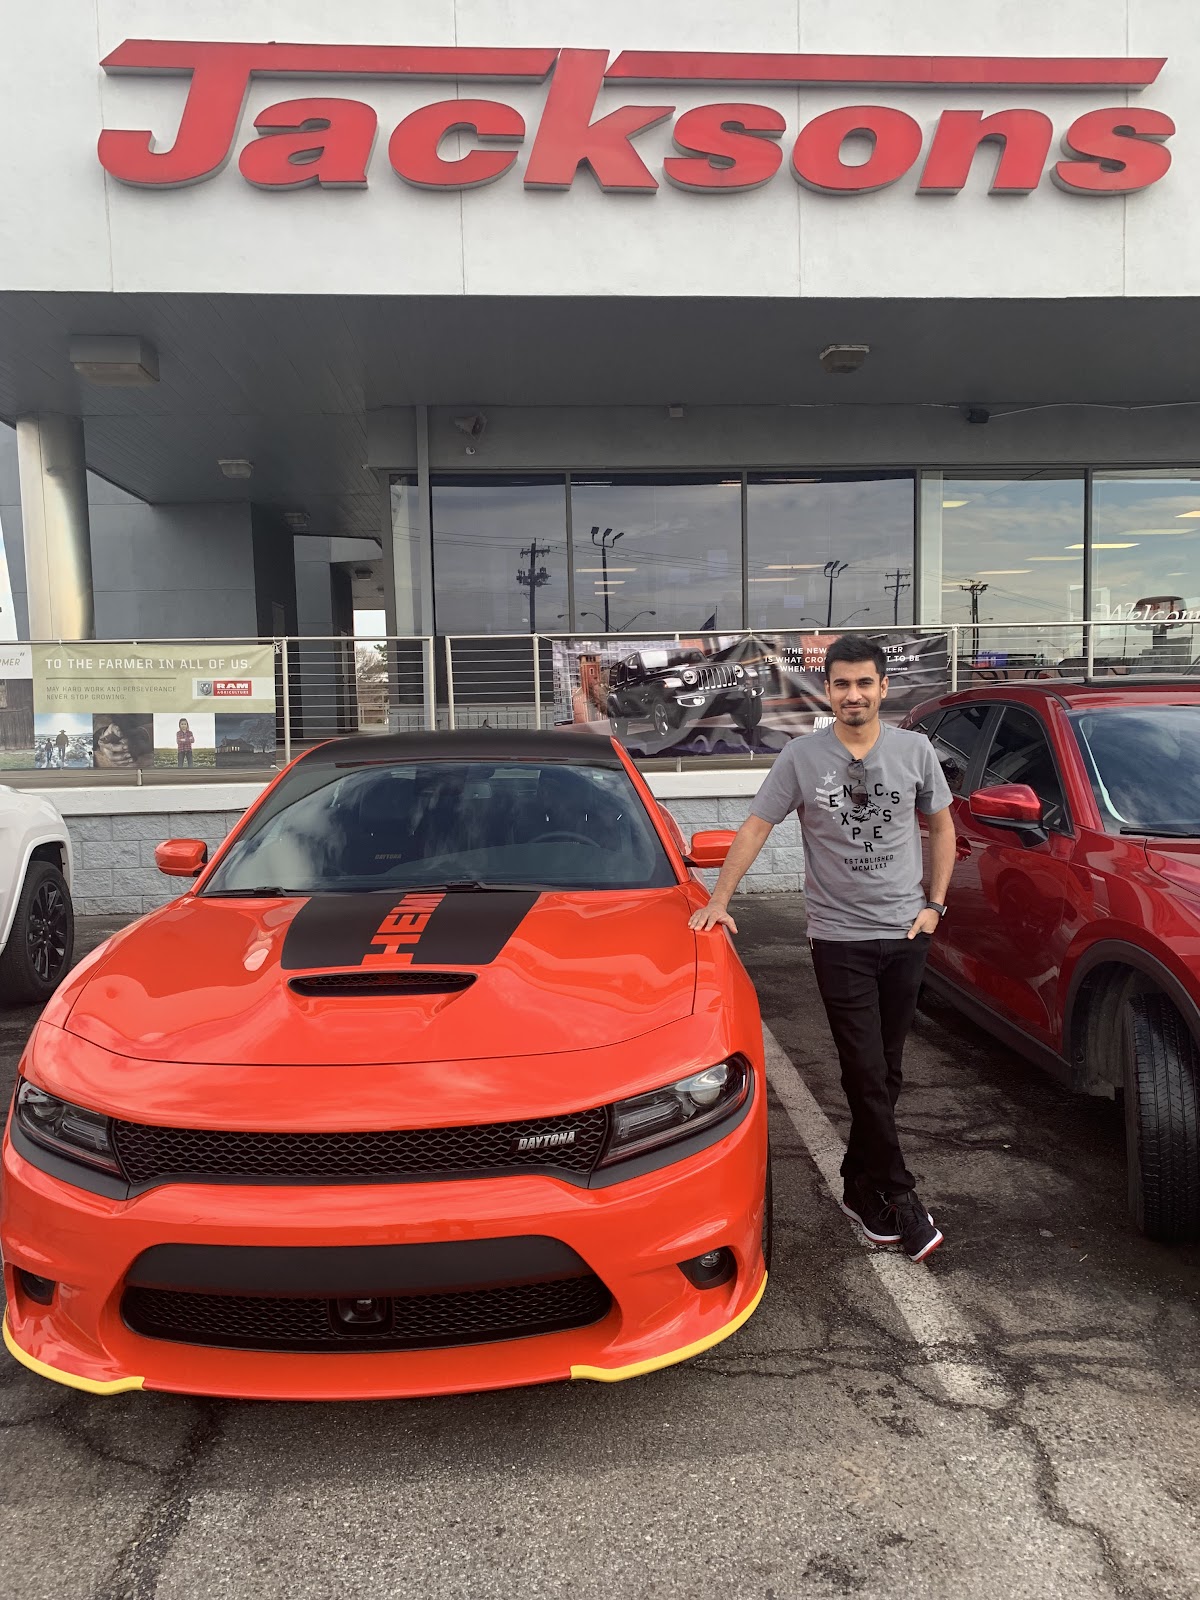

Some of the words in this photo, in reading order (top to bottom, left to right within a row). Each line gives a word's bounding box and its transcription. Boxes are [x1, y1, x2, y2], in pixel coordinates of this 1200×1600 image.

[97, 38, 1176, 196] Jacksons
[1095, 602, 1200, 627] Welcom
[806, 647, 827, 655] NEW
[45, 659, 62, 669] TO
[67, 659, 93, 669] THE
[98, 658, 153, 669] FARMER
[158, 659, 174, 669] IN
[179, 659, 204, 669] ALL
[208, 659, 225, 669] OF
[230, 659, 252, 669] US.
[776, 656, 801, 664] WHAT
[844, 854, 894, 864] ESTABLISHED
[517, 1131, 575, 1151] DAYTONA
